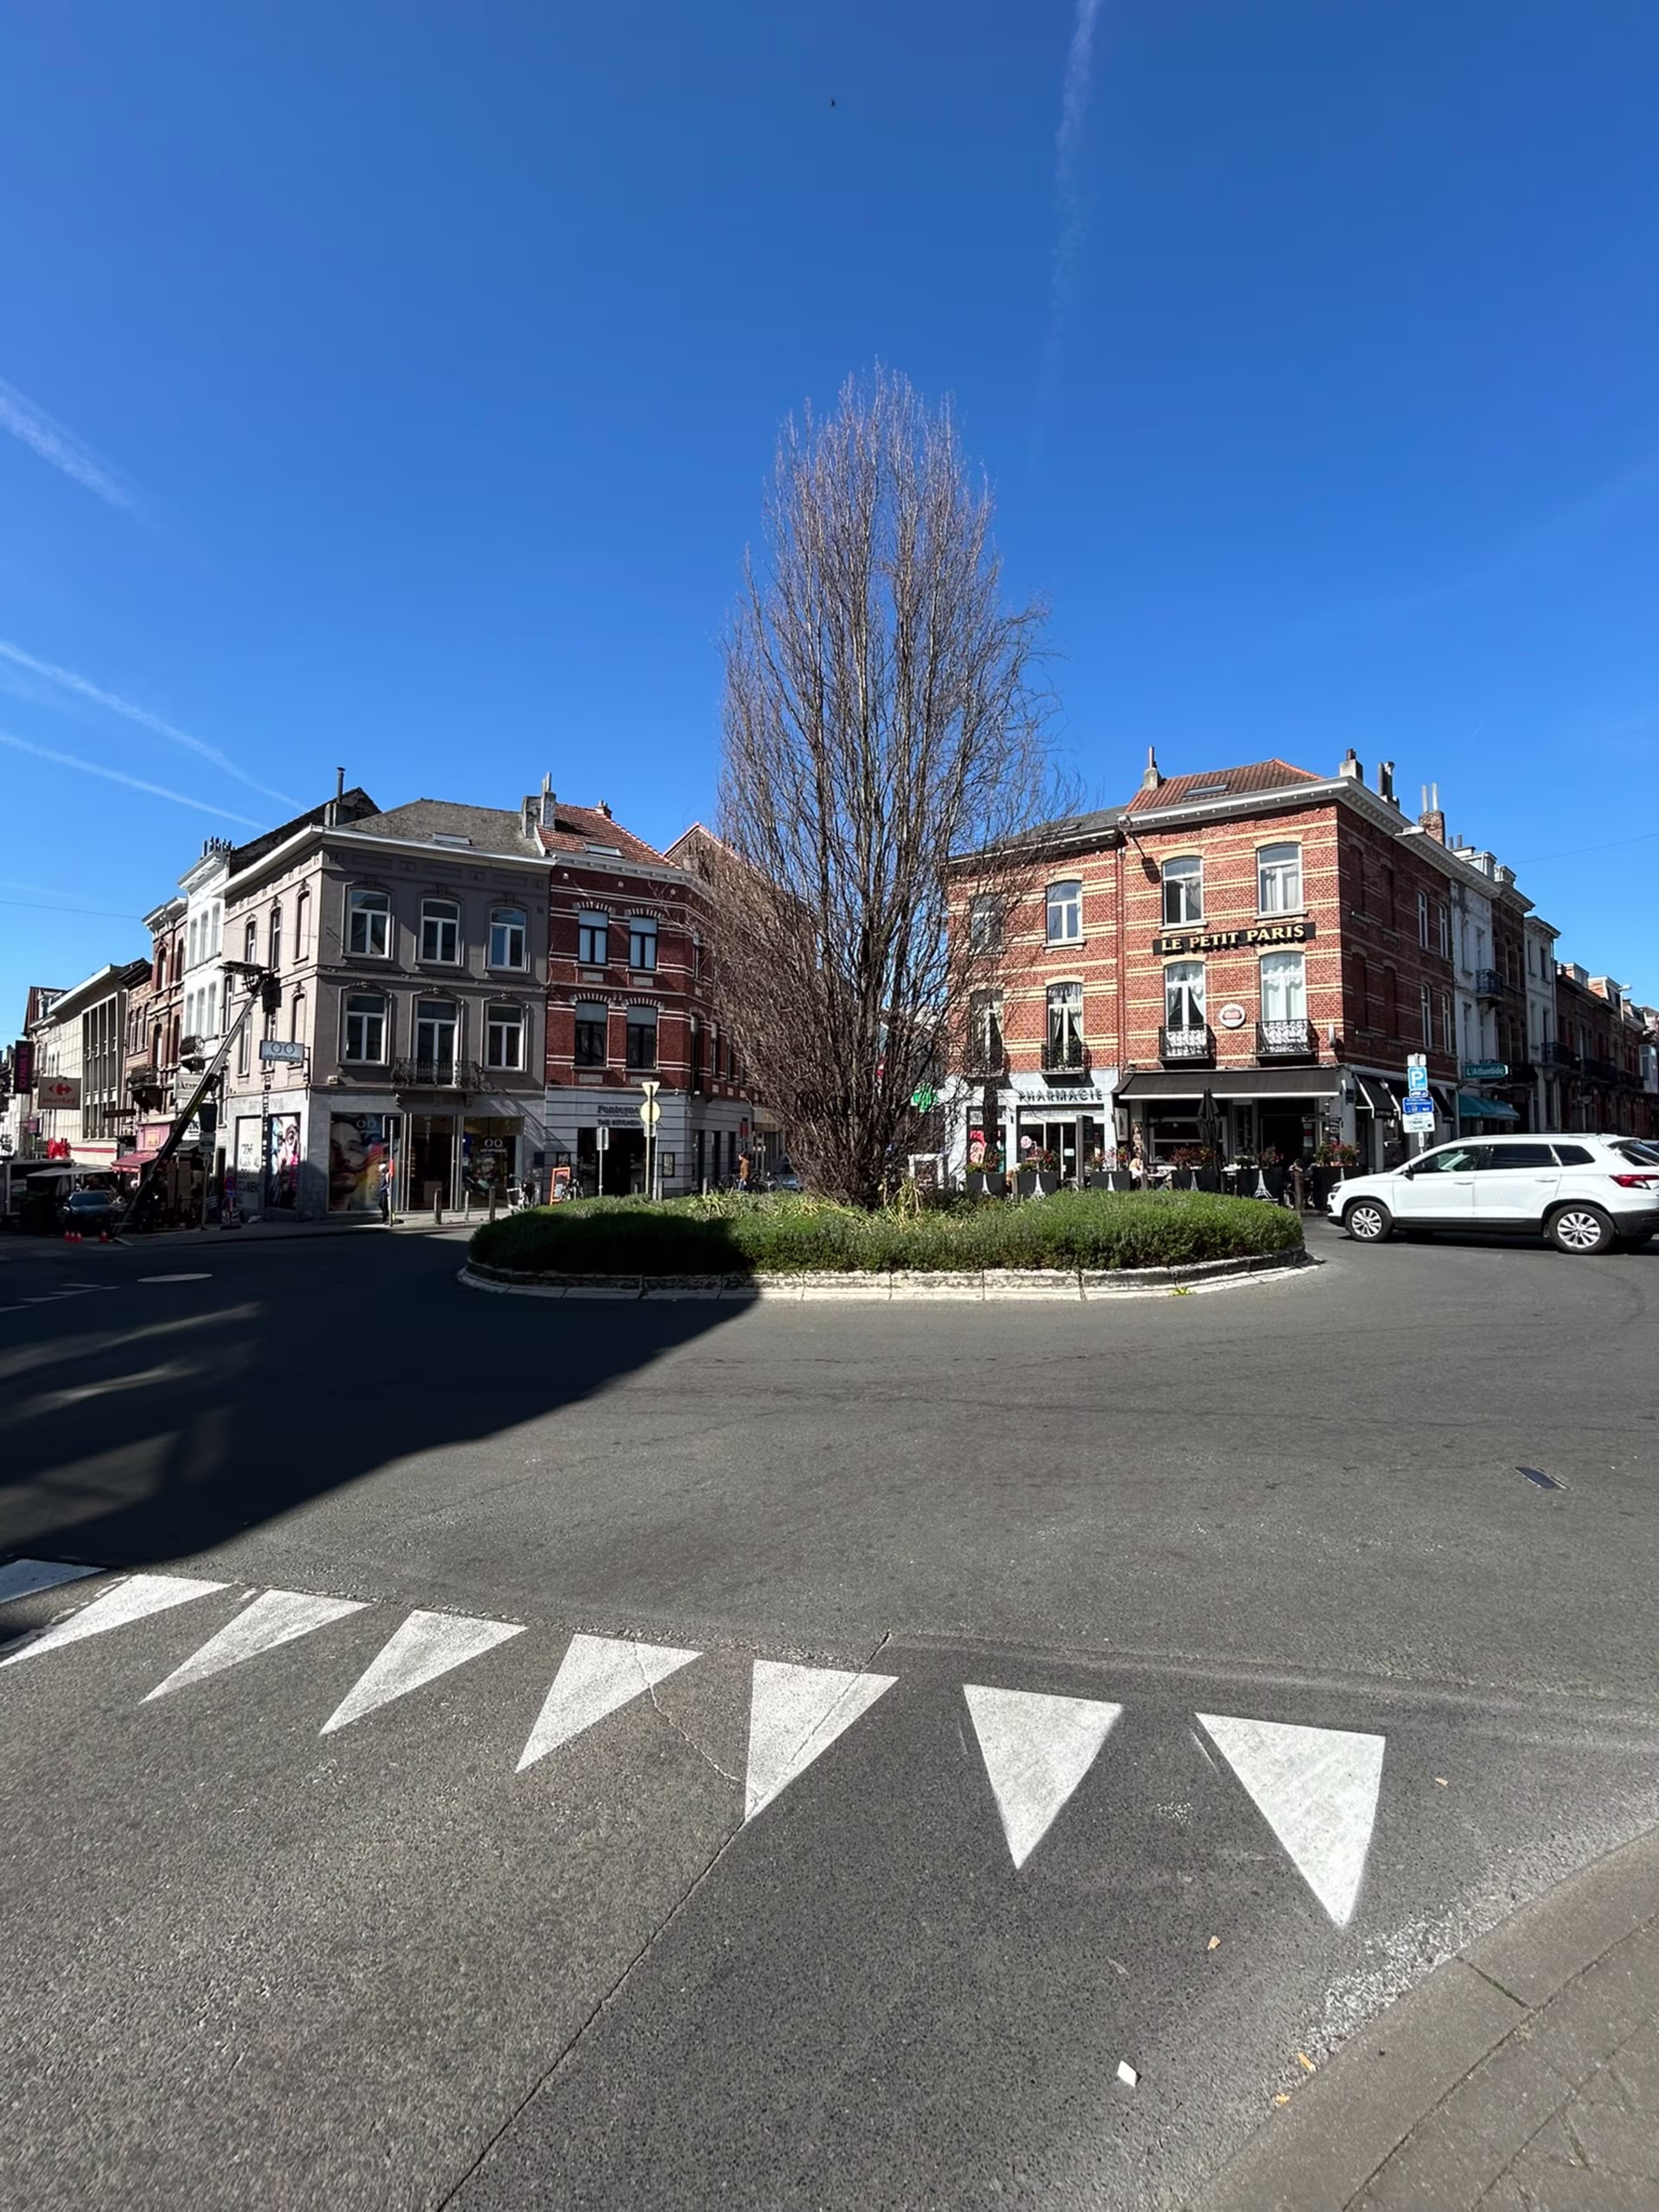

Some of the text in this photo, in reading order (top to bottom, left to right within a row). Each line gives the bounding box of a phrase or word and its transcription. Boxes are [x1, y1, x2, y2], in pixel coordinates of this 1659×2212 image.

[1161, 925, 1305, 951] LE PETIT PARIS
[1466, 1066, 1504, 1076] L'Atlantide
[1411, 1071, 1424, 1086] P
[1018, 1088, 1103, 1102] PHARMACIE
